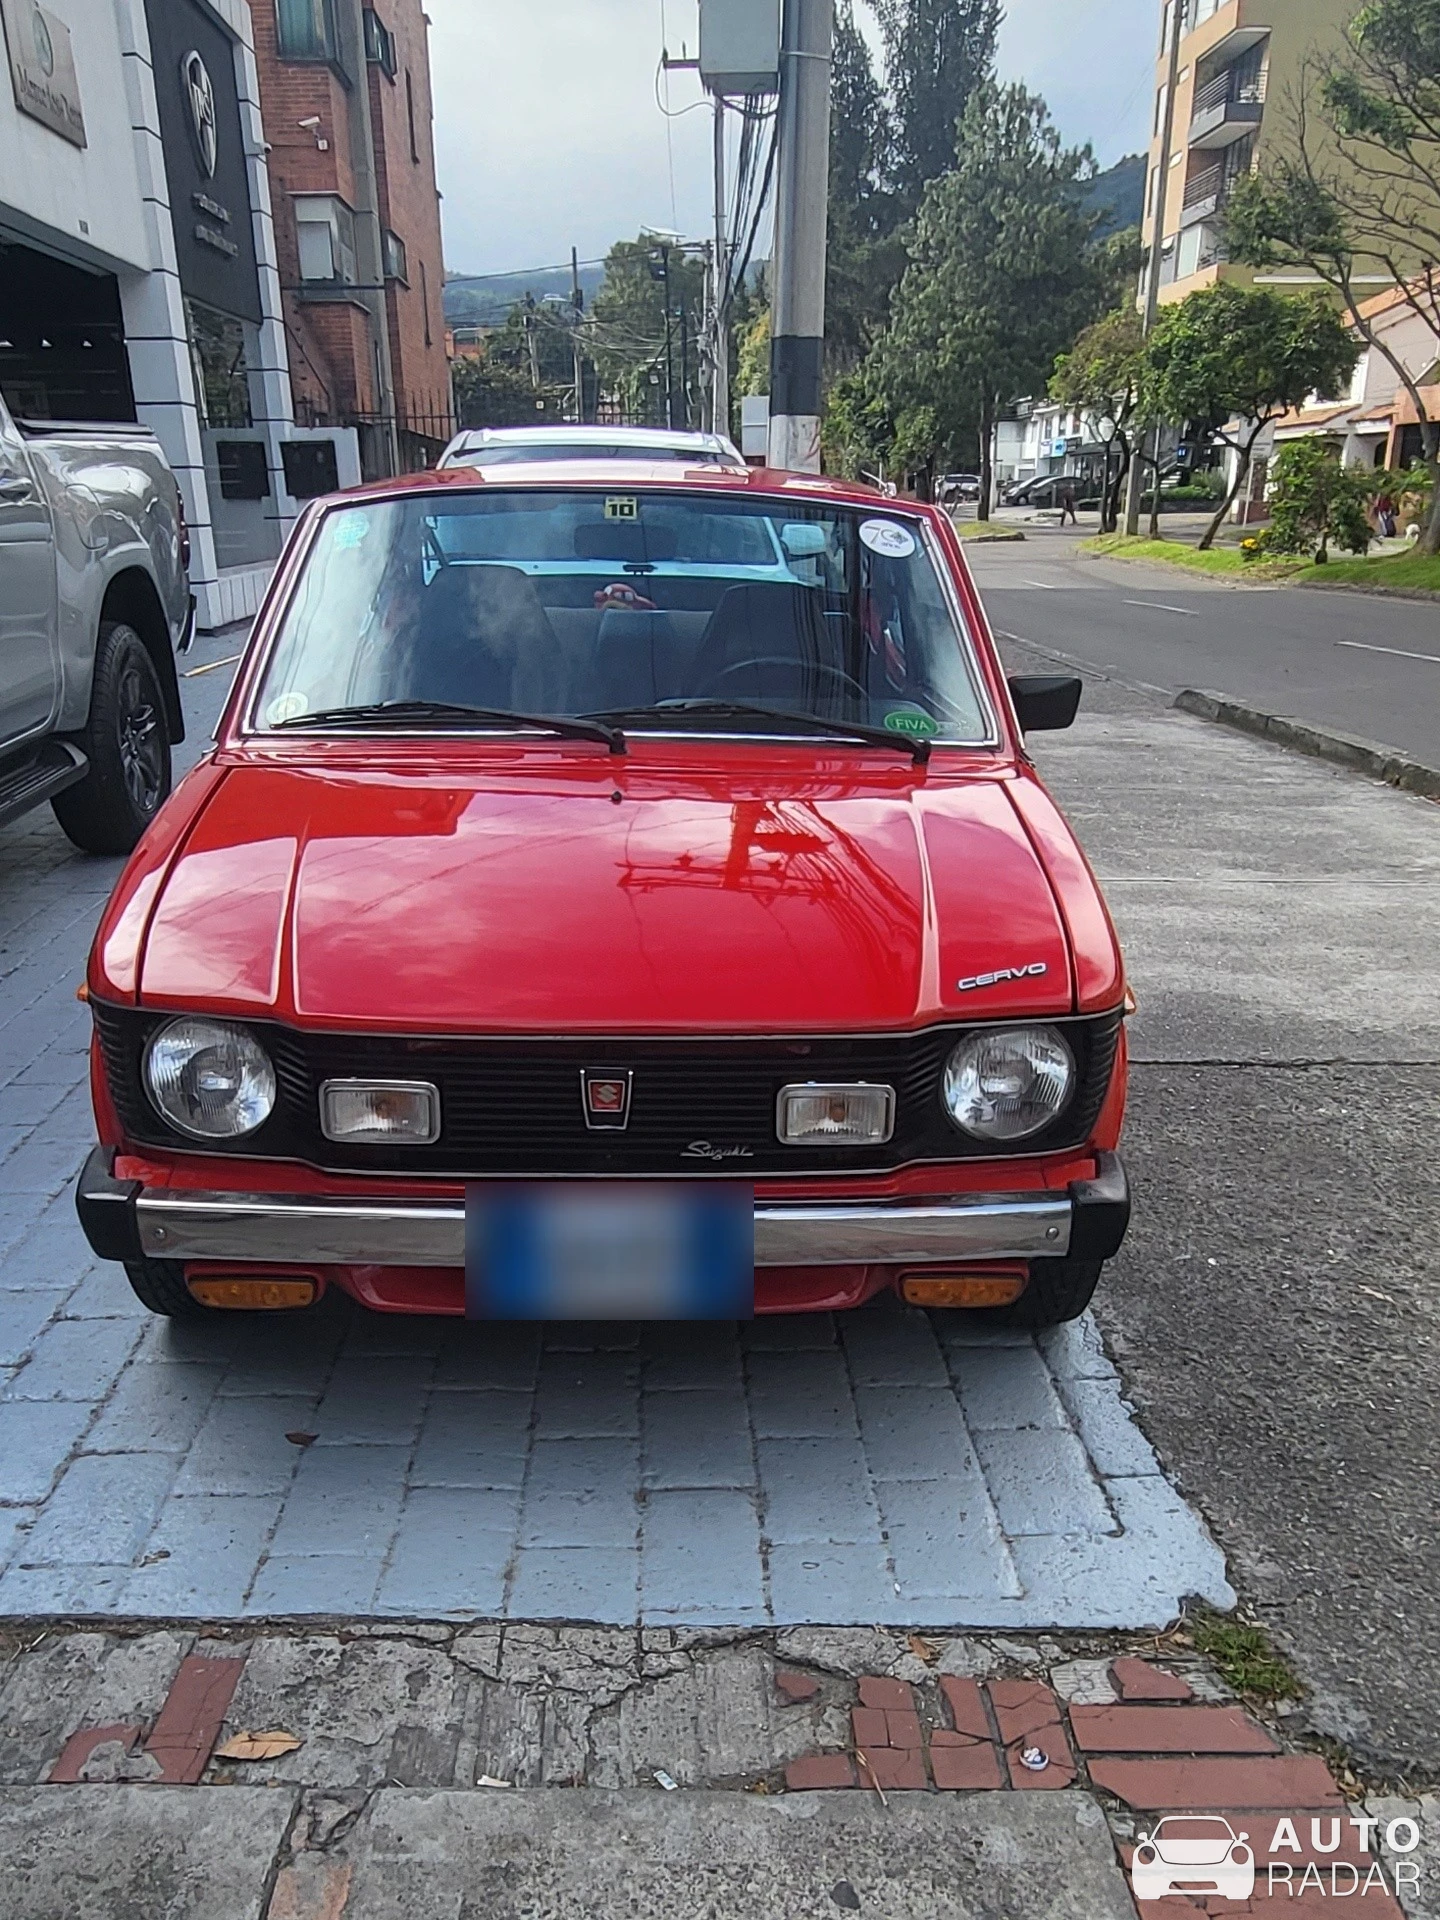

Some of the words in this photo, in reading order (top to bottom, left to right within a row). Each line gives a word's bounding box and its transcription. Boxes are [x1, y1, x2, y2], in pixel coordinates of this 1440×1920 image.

[608, 504, 634, 516] 10
[895, 718, 930, 731] FIVA
[958, 962, 1047, 990] CERVO
[680, 1140, 754, 1160] Suzuki
